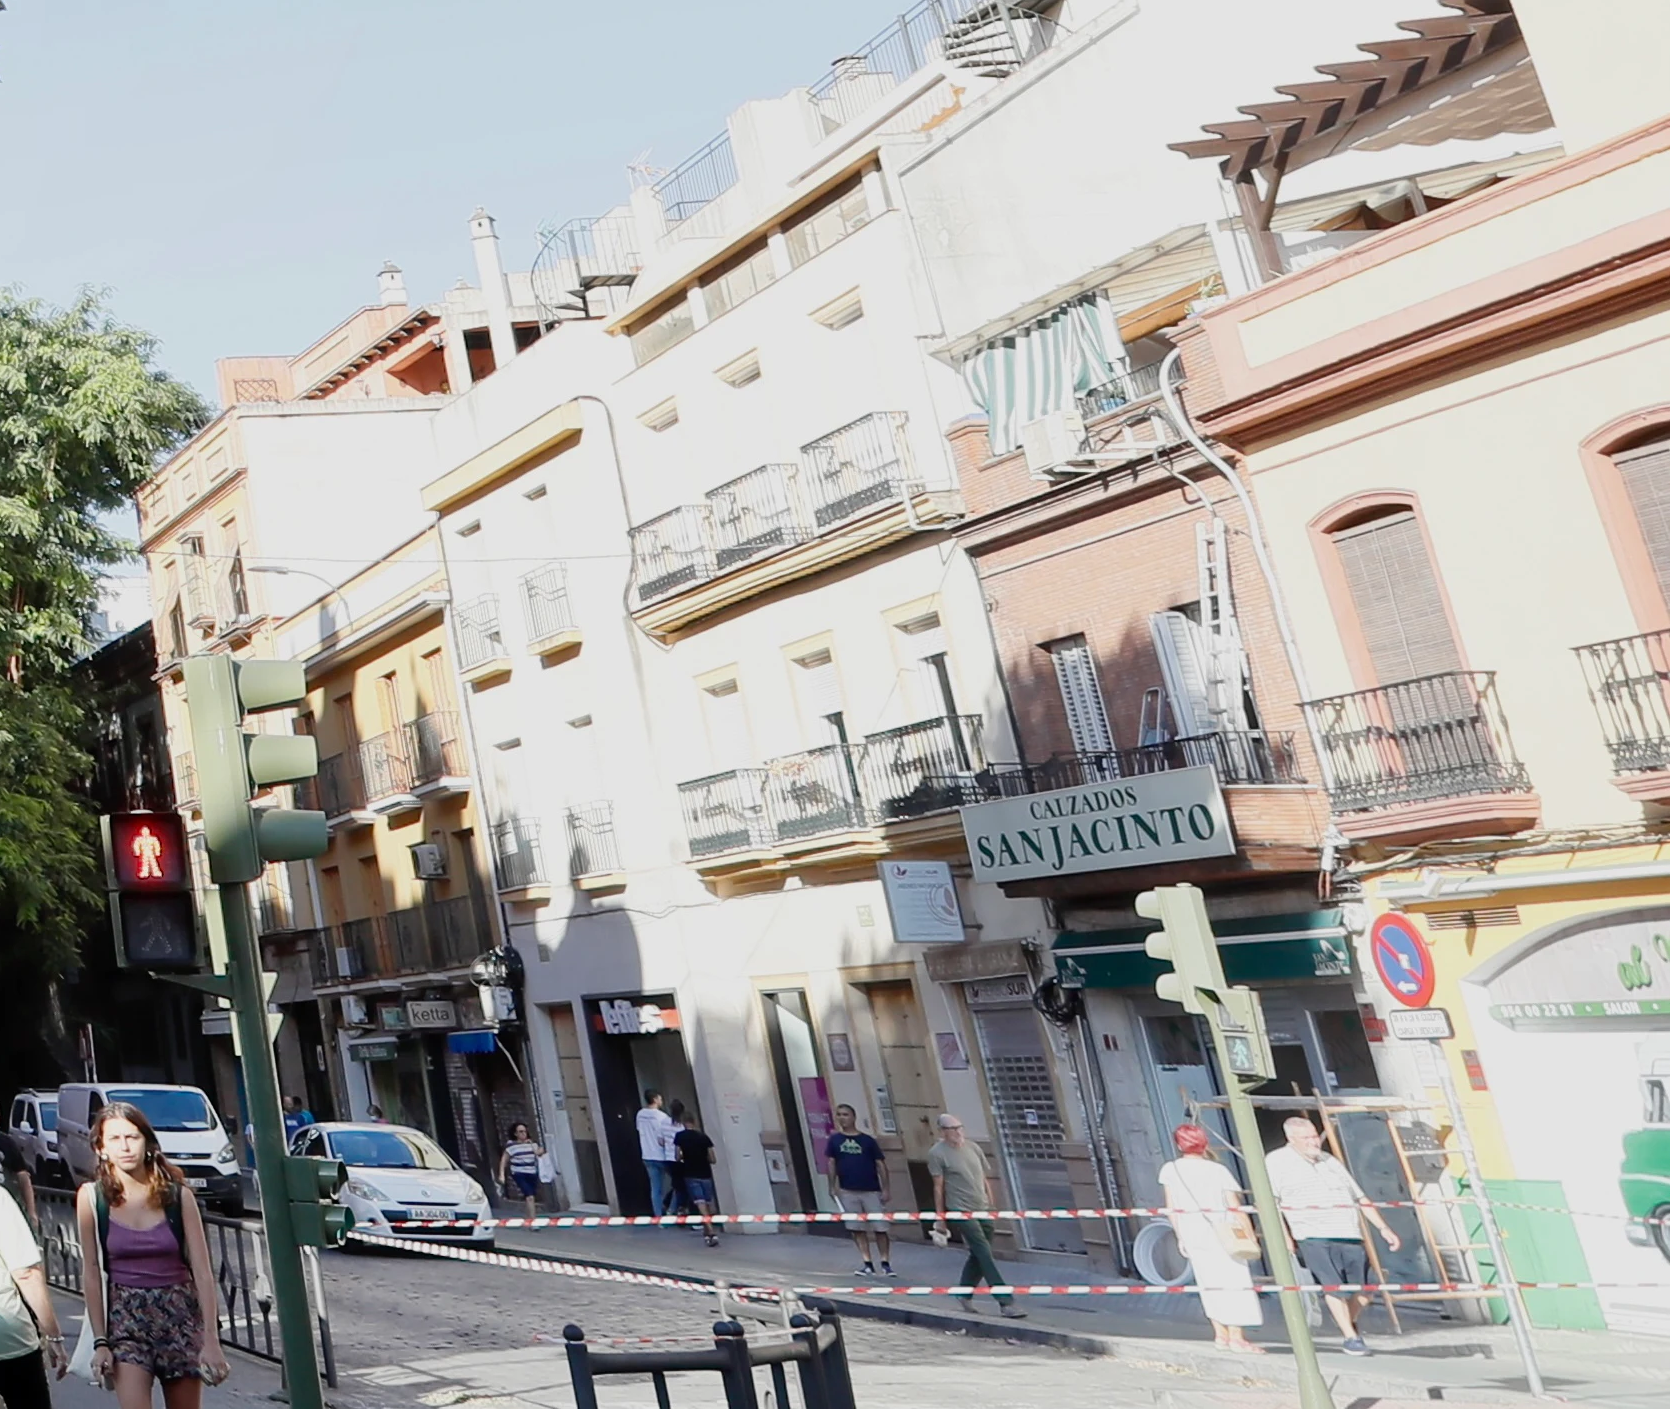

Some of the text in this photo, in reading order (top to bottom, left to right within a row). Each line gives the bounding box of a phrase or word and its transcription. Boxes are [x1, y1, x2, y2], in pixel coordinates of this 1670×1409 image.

[1029, 786, 1137, 820] CALZADOS
[977, 804, 1215, 871] SAN JACINTO
[411, 1007, 450, 1022] ketta
[1500, 1001, 1642, 1018] 954 00 22 91 SALON
